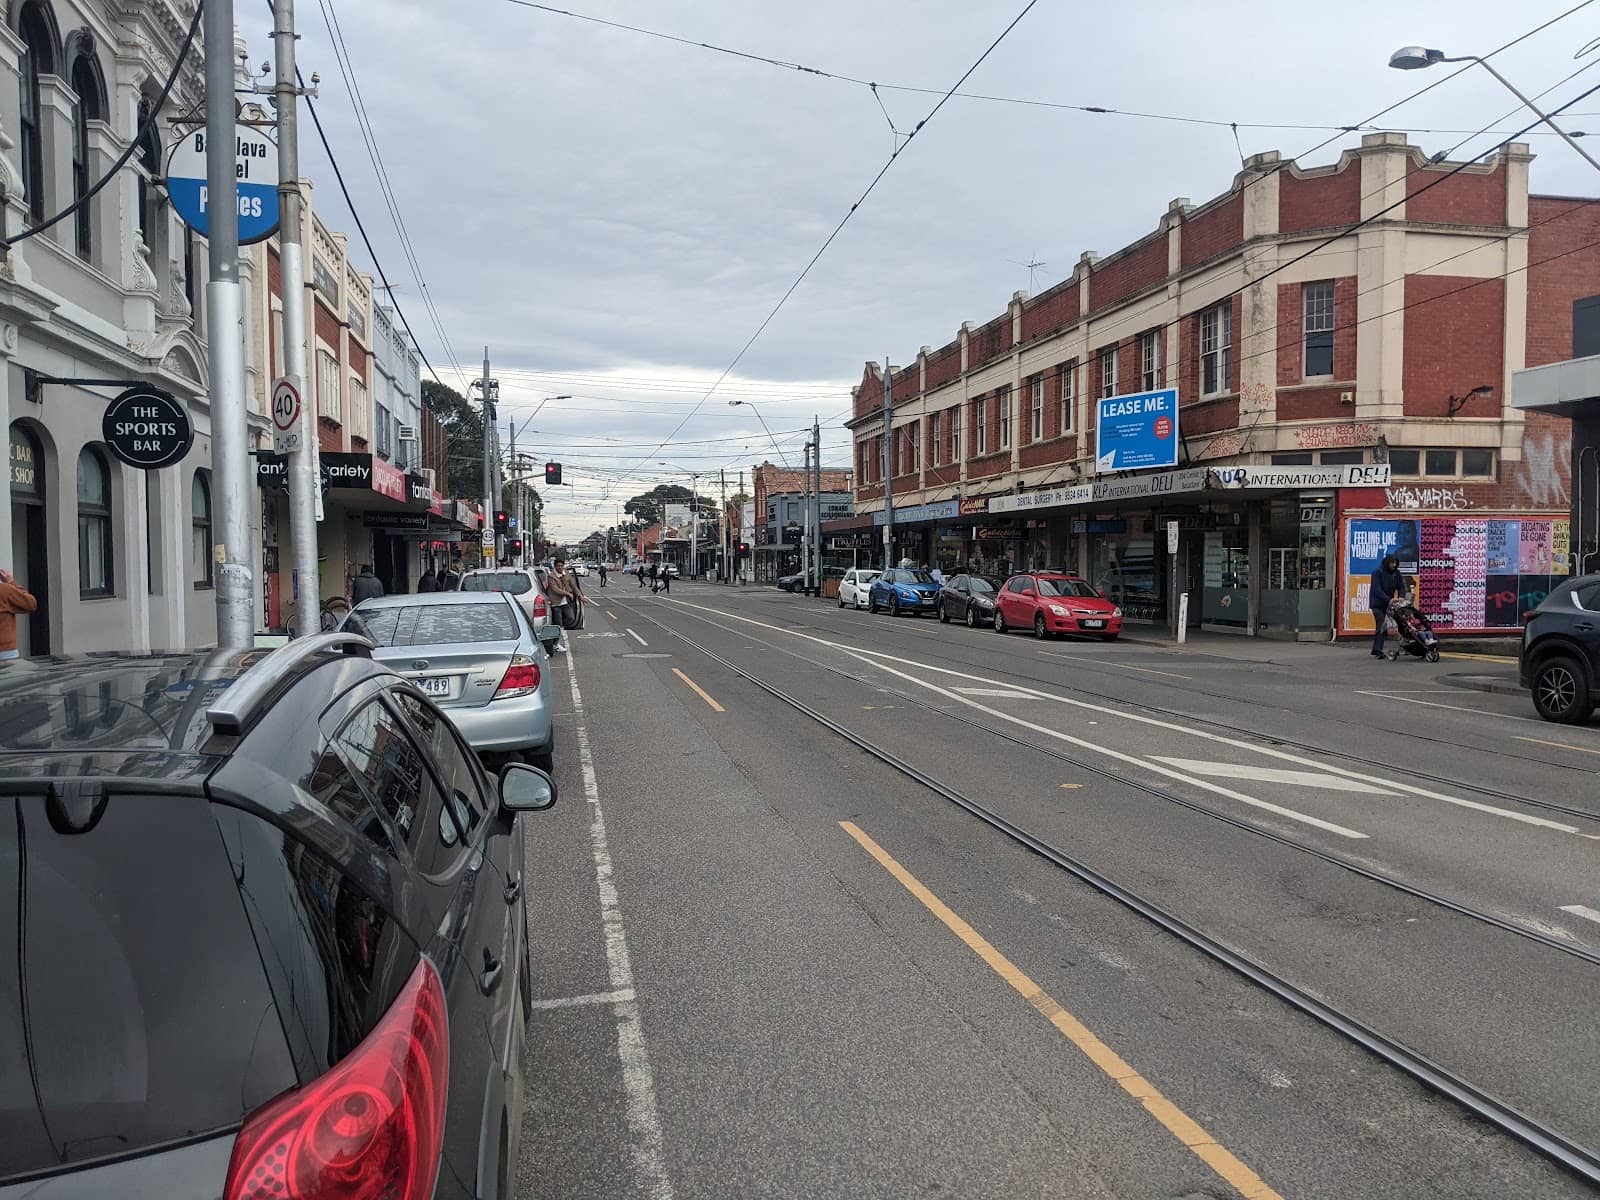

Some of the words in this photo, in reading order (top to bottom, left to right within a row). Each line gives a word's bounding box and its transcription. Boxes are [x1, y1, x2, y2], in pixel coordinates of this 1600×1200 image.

[195, 133, 266, 158] Blava
[200, 186, 262, 217] Pies
[131, 406, 159, 418] THE
[276, 394, 293, 417] 40
[1103, 400, 1141, 418] LEASE
[1144, 396, 1169, 412] ME.
[115, 422, 177, 436] SPORTS
[133, 439, 161, 451] BAR
[16, 445, 32, 463] BAR
[15, 467, 34, 484] SHOP
[326, 464, 370, 480] ariety
[1349, 467, 1389, 484] DELI
[1151, 475, 1174, 493] DELI
[1521, 522, 1550, 532] BLOATING
[1354, 531, 1380, 545] FEELING
[1382, 531, 1397, 545] LIKE
[1521, 532, 1529, 541] BE
[1530, 532, 1546, 541] GONE
[1419, 559, 1454, 568] boutique
